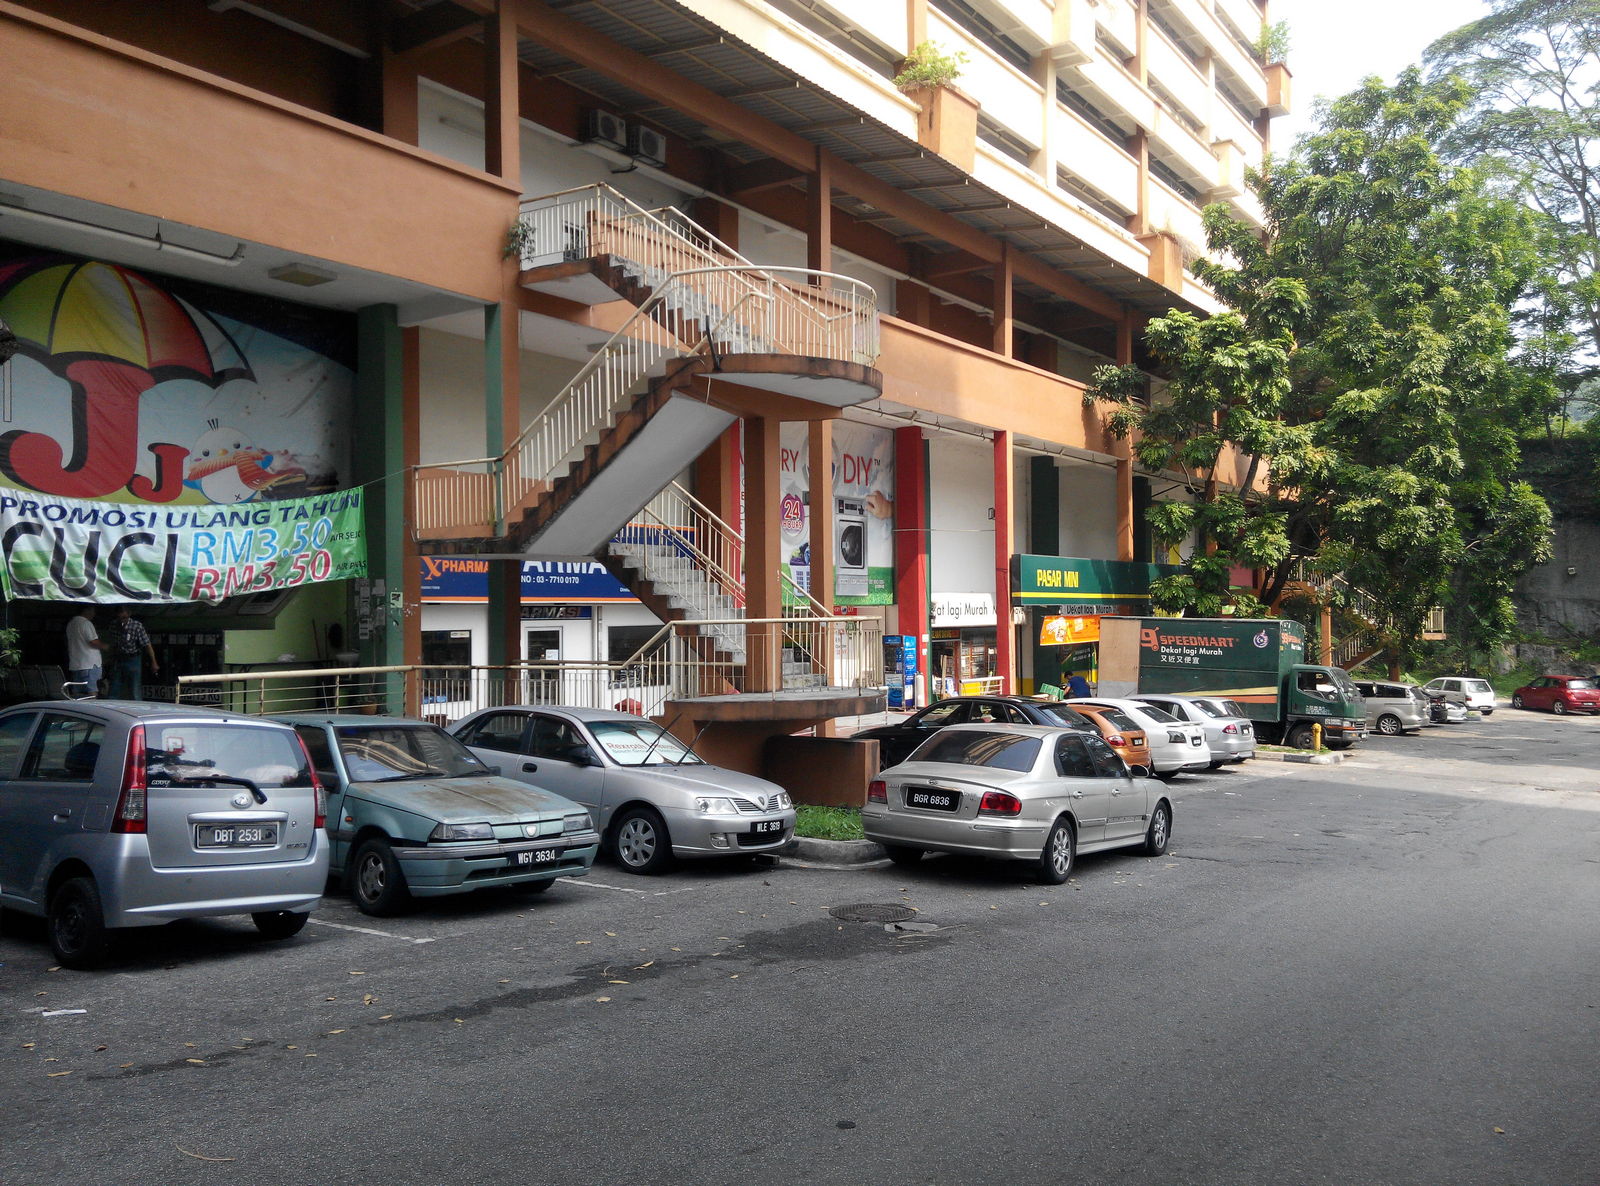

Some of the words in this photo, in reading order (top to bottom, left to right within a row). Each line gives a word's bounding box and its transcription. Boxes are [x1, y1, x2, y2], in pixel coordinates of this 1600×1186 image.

[843, 453, 873, 486] DIY
[1, 496, 157, 528] PROMOSI
[166, 507, 271, 528] ULANG
[279, 494, 360, 524] TAHUN
[784, 499, 800, 519] 24
[190, 517, 333, 569] RM3.50
[1, 521, 181, 600] CUCI
[189, 550, 331, 601] RM3.50
[521, 575, 532, 583] NO
[536, 576, 545, 584] 03
[549, 576, 564, 584] 7710
[1036, 569, 1061, 587] PASAR
[1063, 570, 1079, 588] MINI
[947, 601, 962, 619] lagi
[964, 602, 988, 616] Murah
[1159, 635, 1234, 647] SPEEDMART
[1183, 646, 1197, 656] lagi
[1199, 648, 1223, 656] Murah
[913, 793, 929, 804] BGR
[930, 795, 950, 806] 6836
[214, 829, 235, 842] DBT
[238, 828, 262, 841] 2531
[518, 852, 534, 864] WGY
[535, 849, 555, 863] 3634
